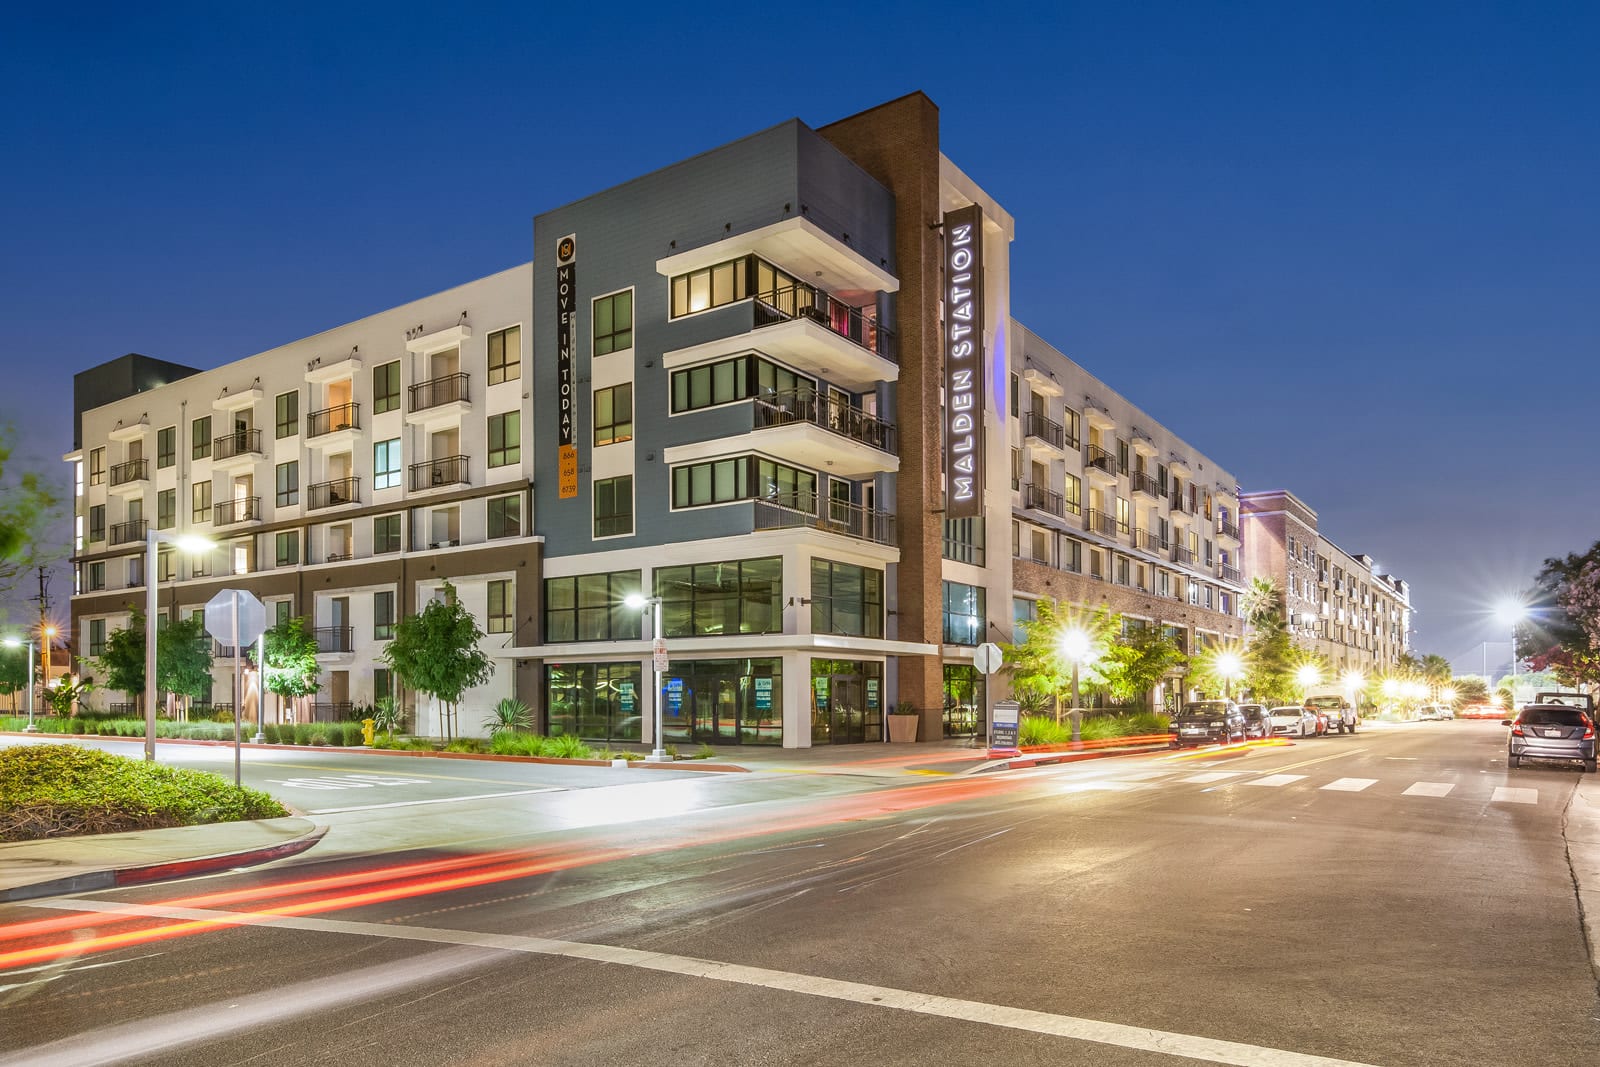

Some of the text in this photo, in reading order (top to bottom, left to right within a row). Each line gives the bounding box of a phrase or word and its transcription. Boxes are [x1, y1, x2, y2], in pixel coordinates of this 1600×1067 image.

[560, 268, 570, 439] MOVE IN TODAY
[951, 224, 973, 500] MALDEN STATION
